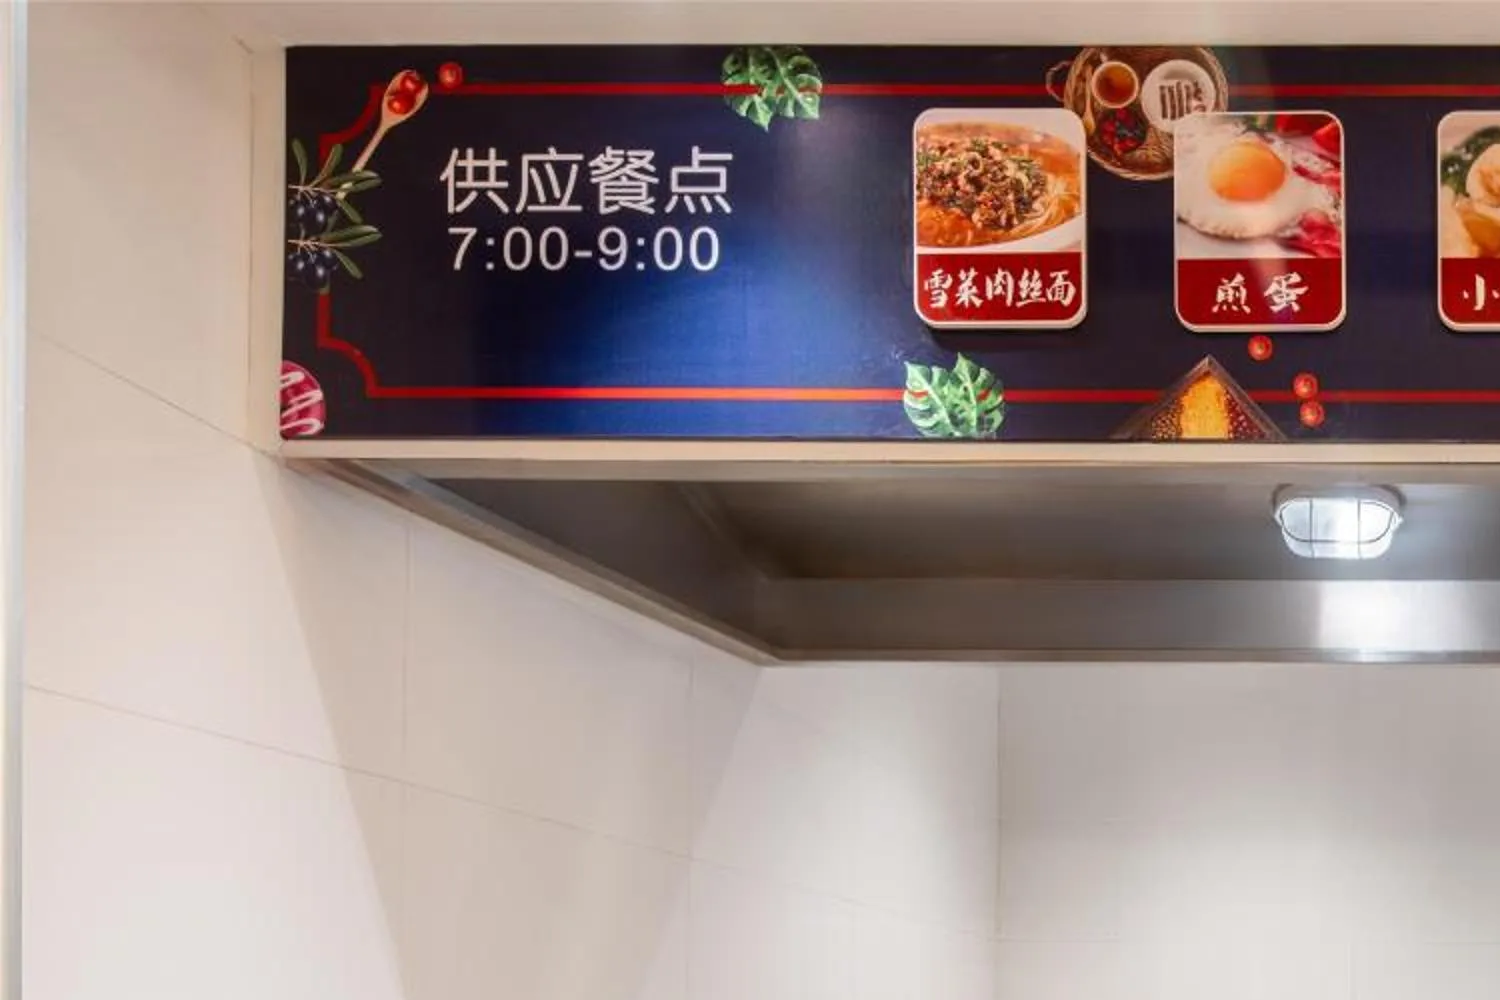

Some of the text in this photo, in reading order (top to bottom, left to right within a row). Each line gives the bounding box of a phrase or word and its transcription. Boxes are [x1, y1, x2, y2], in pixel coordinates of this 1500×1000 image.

[439, 145, 734, 214] 供应餐点
[448, 226, 720, 271] 7:00-9:00
[924, 267, 1076, 309] 雪菜肉丝面
[1211, 271, 1309, 314] 煎蛋
